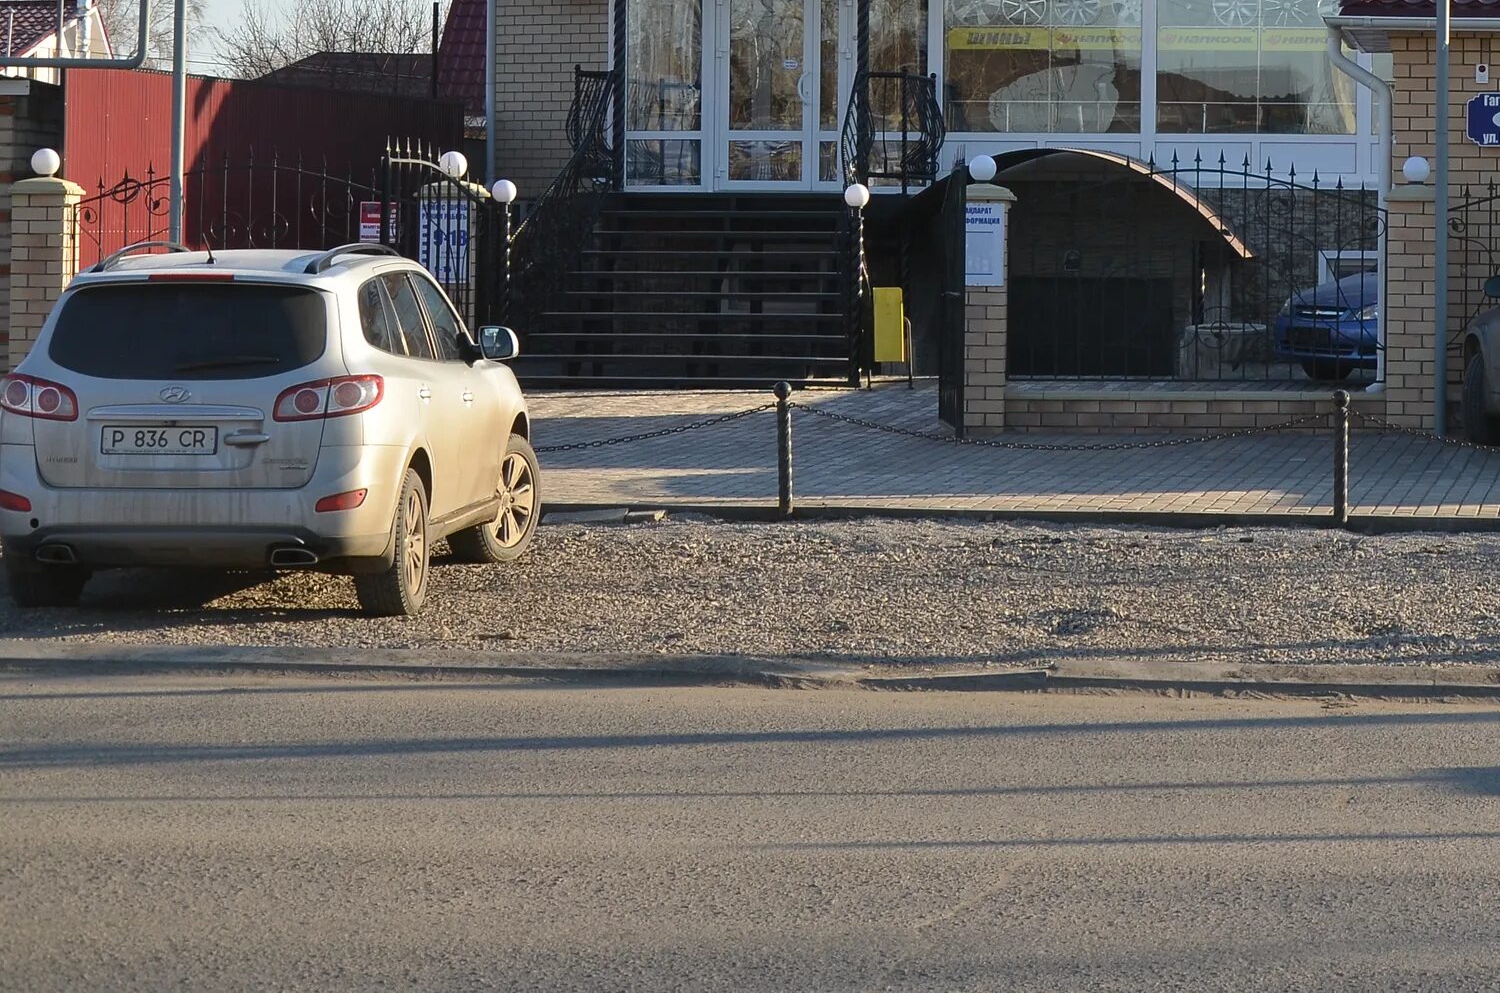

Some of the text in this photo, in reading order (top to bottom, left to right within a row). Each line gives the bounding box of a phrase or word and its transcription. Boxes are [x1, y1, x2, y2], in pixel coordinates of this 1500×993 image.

[967, 32, 1031, 45] ШИНЫ
[1483, 133, 1498, 144] ул.
[966, 217, 1000, 225] ФОРМАЦИЯ
[112, 430, 206, 448] P 836 CR
